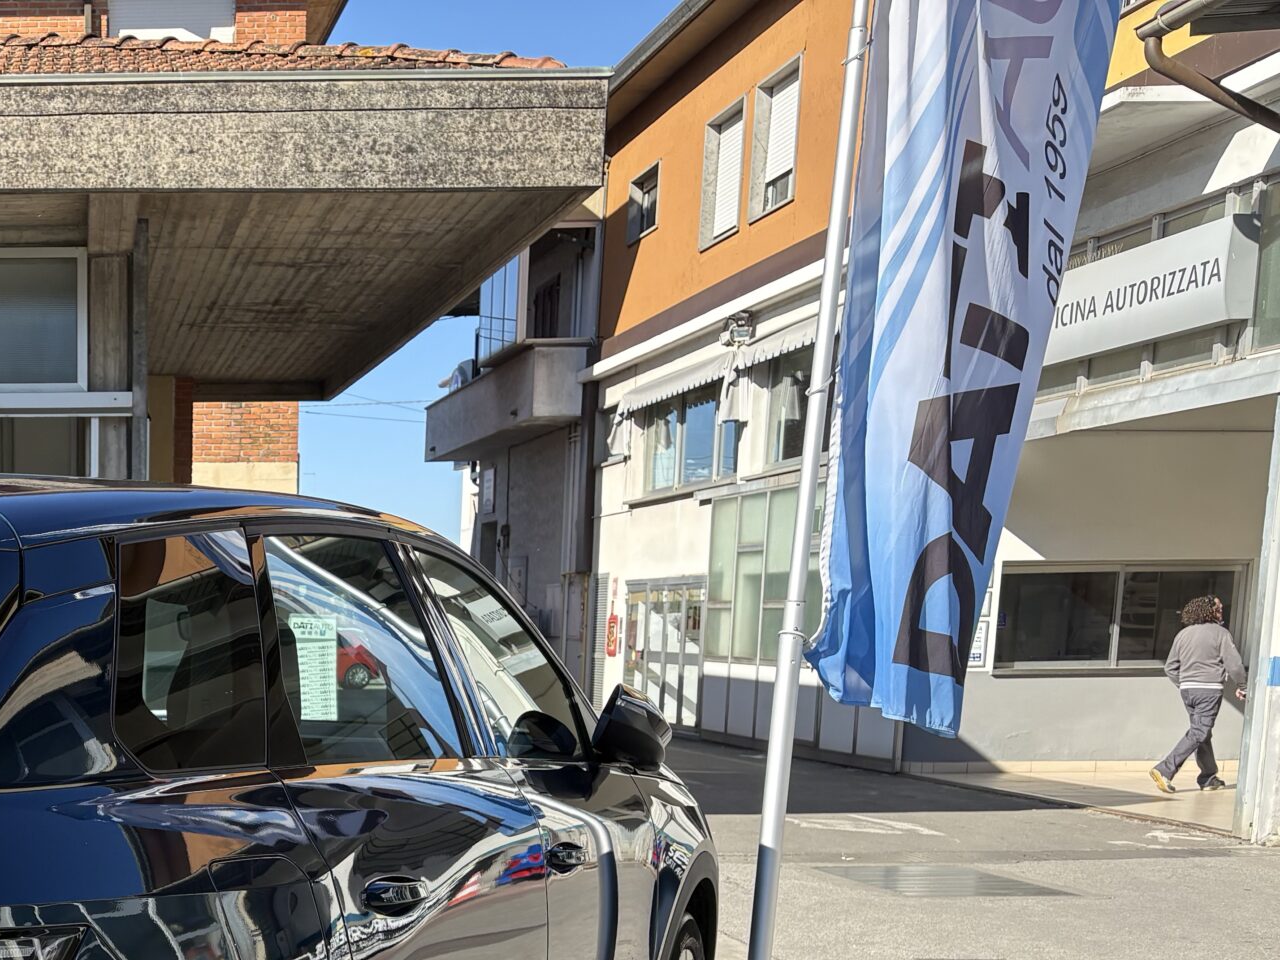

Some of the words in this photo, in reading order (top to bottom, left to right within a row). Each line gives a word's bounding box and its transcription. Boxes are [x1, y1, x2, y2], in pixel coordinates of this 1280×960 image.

[1043, 73, 1068, 202] 1959
[1042, 218, 1065, 306] dal
[1102, 257, 1222, 316] AUTORIZZATA
